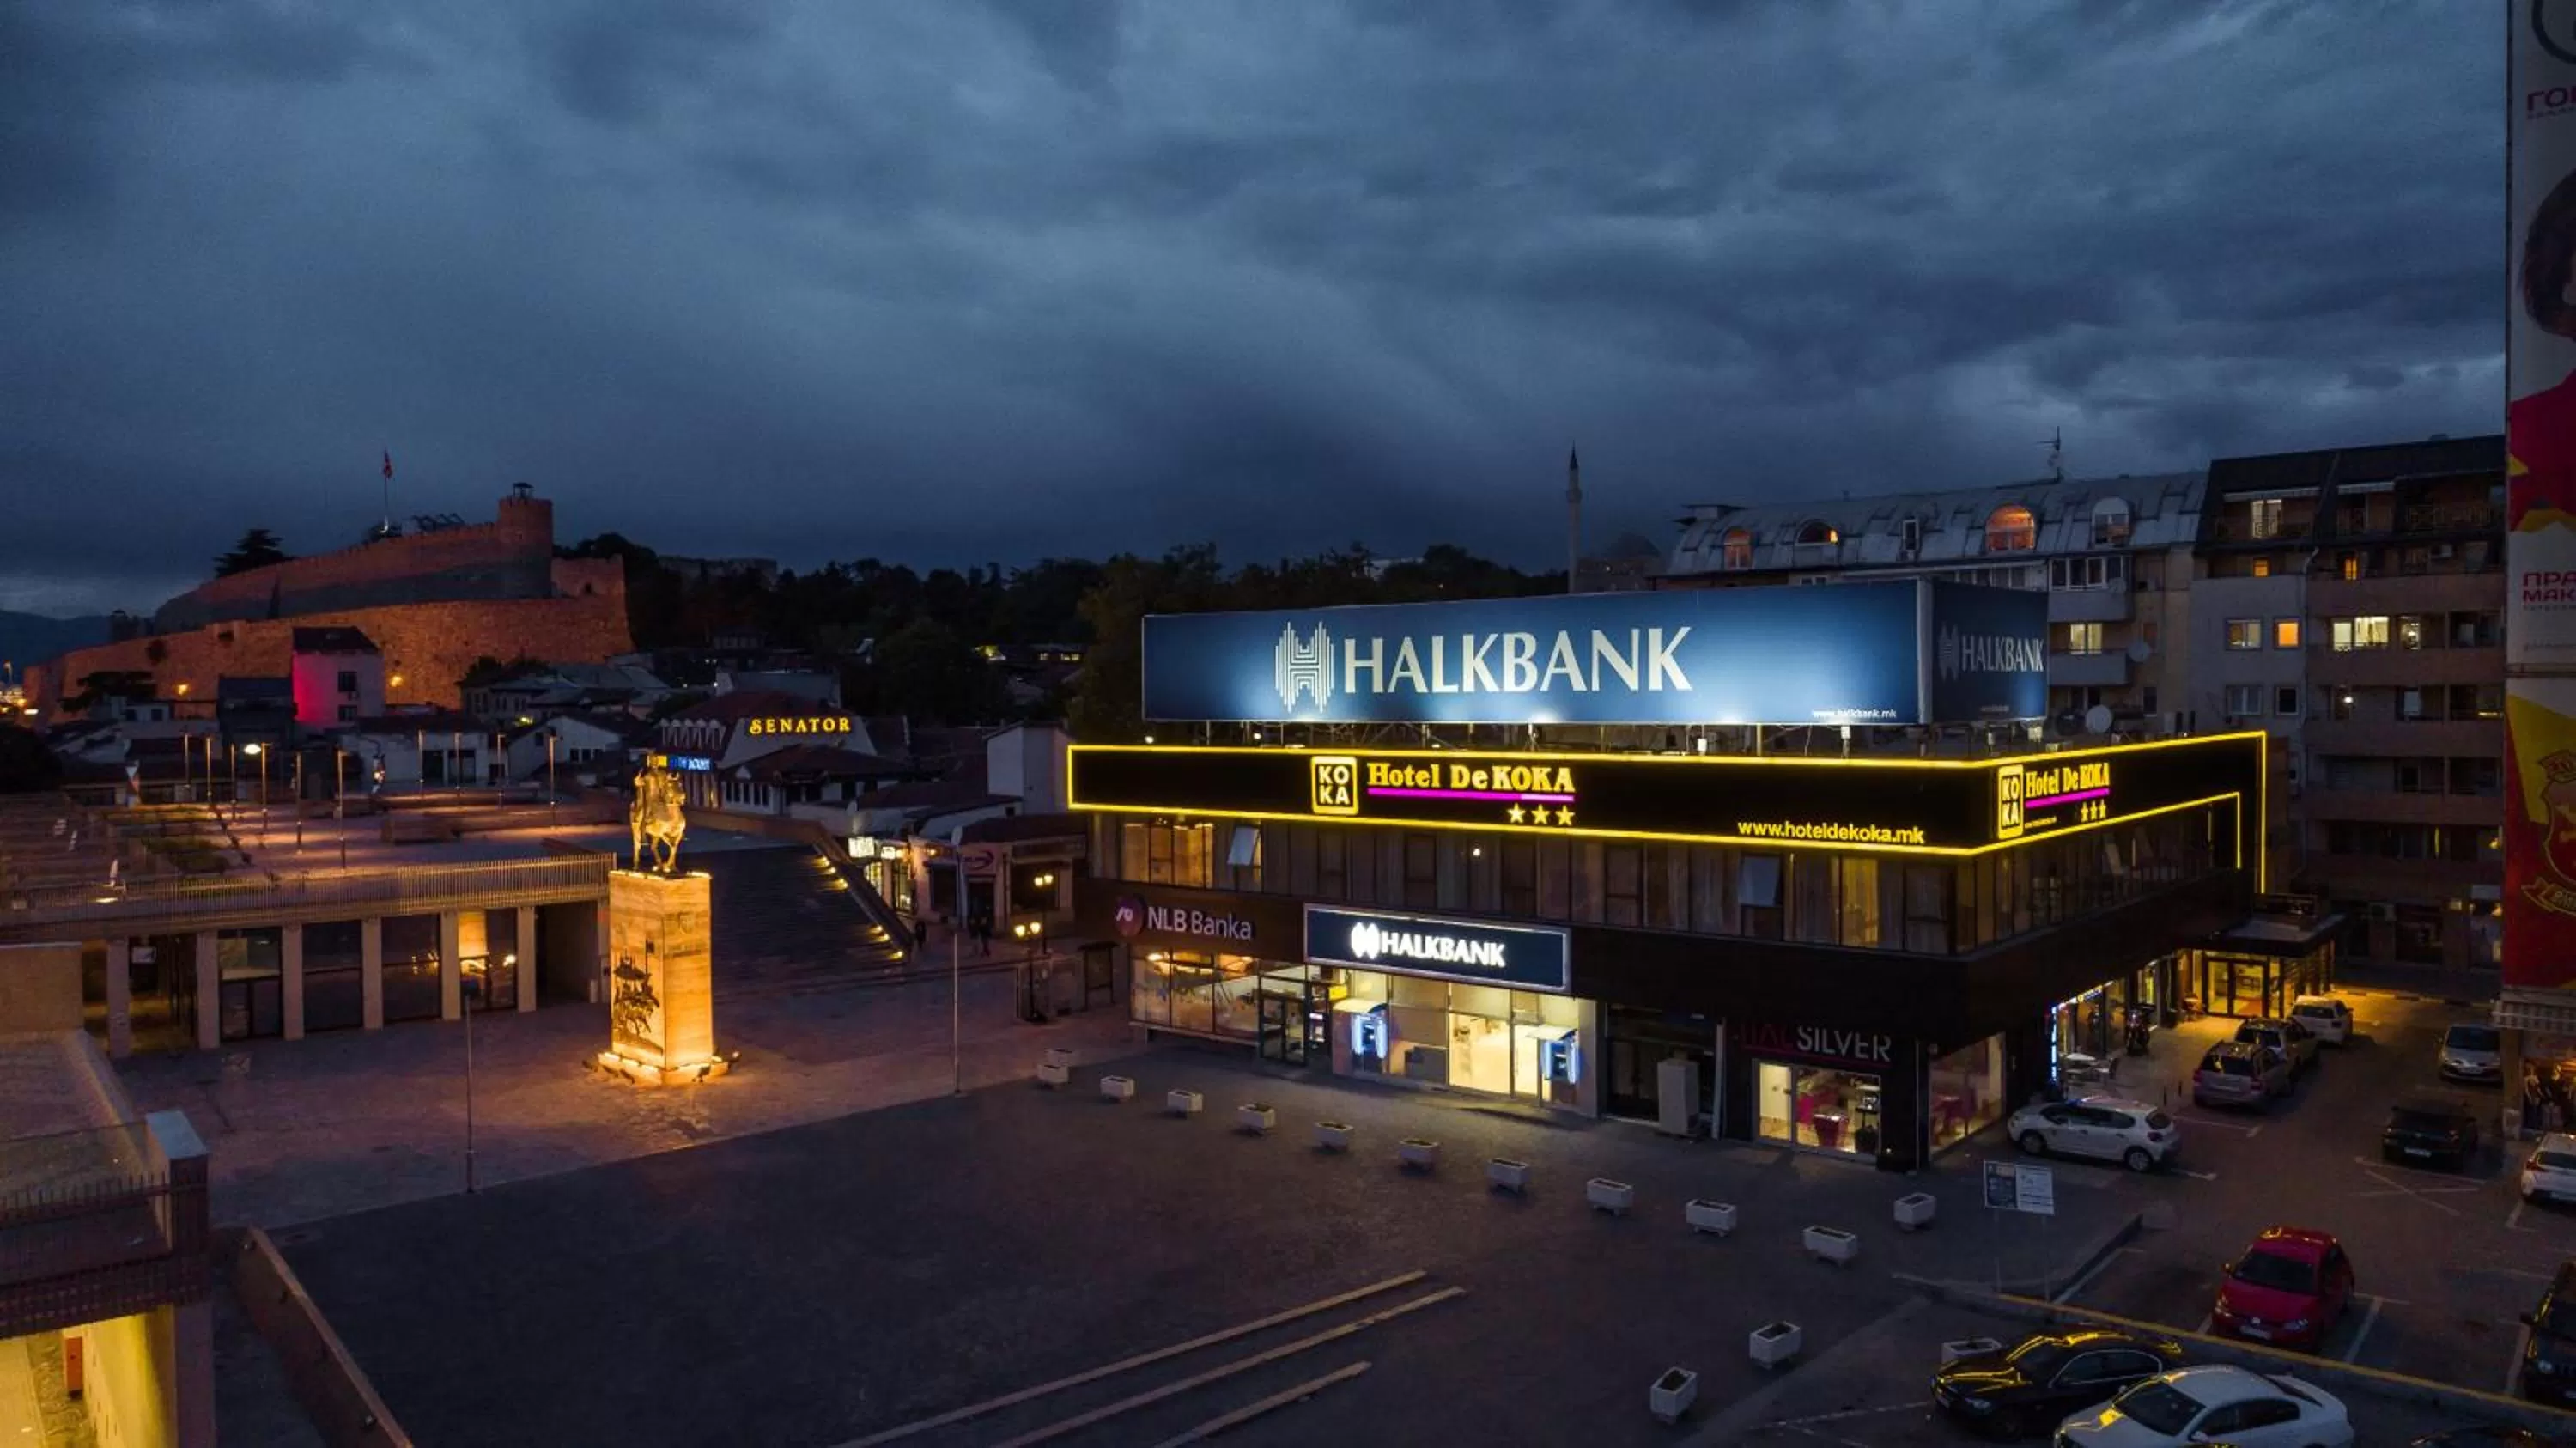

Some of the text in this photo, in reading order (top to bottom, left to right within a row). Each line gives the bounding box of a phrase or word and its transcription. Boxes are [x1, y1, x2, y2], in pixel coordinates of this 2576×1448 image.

[1344, 629, 1692, 693] HALKBANK
[1962, 635, 2044, 672] HALKBANK
[750, 717, 850, 735] SENATOR
[1319, 765, 1349, 785] KO
[1367, 763, 1439, 788] Hotel
[2026, 768, 2059, 798] Hotel
[1320, 785, 1350, 806] KA
[1738, 820, 1925, 844] www.hoteldekoka.mk
[1147, 906, 1252, 940] NLB Banka
[1382, 931, 1505, 967] HALKBANK
[1797, 1025, 1892, 1062] SILVER
